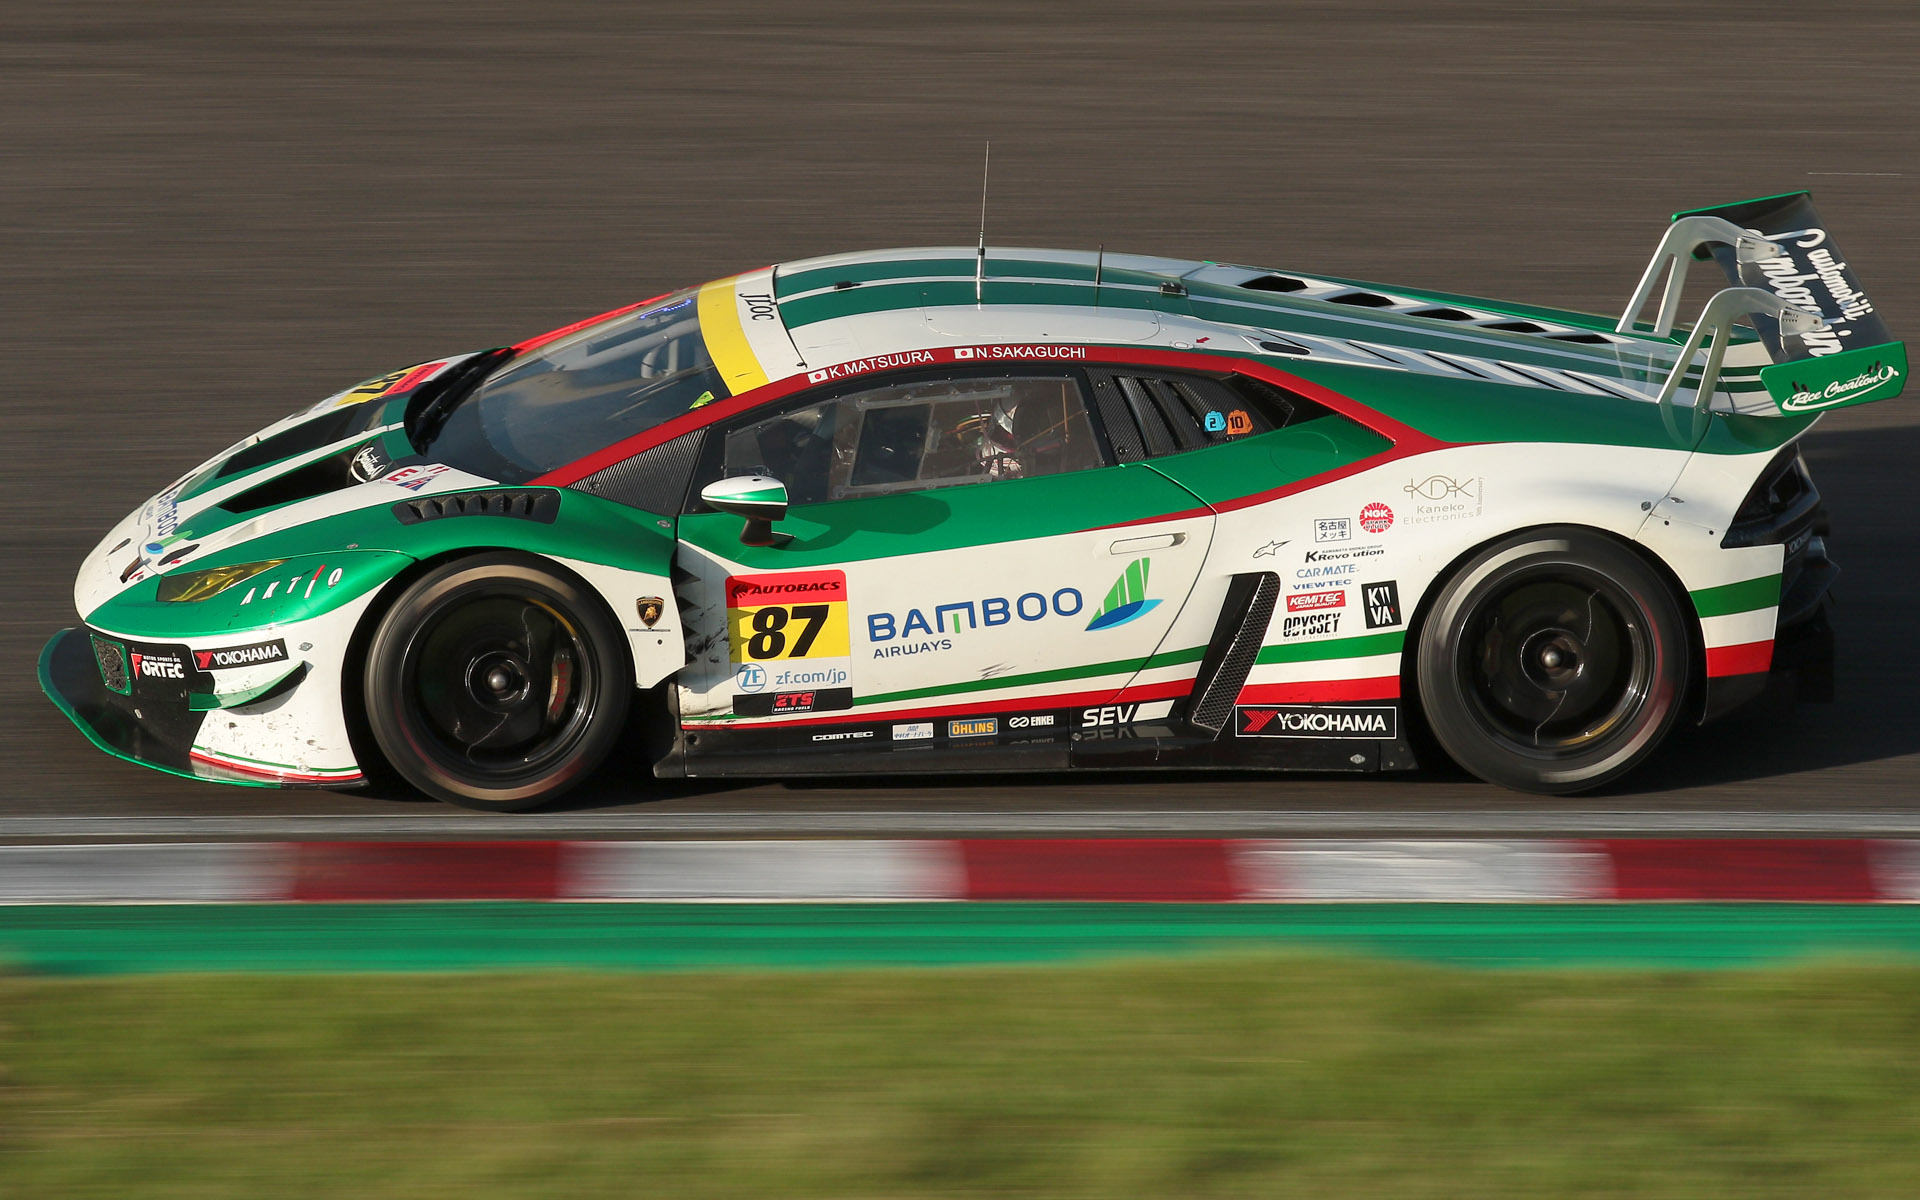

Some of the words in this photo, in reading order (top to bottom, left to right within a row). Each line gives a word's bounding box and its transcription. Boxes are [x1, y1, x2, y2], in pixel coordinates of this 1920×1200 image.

[738, 293, 777, 320] JLOC
[976, 346, 1086, 359] N.SAKAGUCHI
[828, 351, 934, 378] K.MATSUURA
[1792, 390, 1822, 406] Rice
[1824, 373, 1879, 398] Creation
[1209, 418, 1216, 429] 2
[1229, 416, 1245, 429] 10
[1364, 509, 1388, 518] NGK
[1416, 504, 1465, 514] Kaneko
[1319, 521, 1347, 530] 名古屋
[1403, 512, 1474, 525] Electronics
[1320, 530, 1347, 540] メッキ
[240, 564, 343, 606] AKTIO
[749, 581, 840, 595] AUTOBACS
[1292, 579, 1352, 590] VIEWTEC
[867, 587, 1083, 642] BAMBOO
[748, 604, 829, 660] 87
[1283, 612, 1341, 637] ODYSSEY
[212, 644, 282, 665] YOKOHAMA
[873, 639, 953, 659] AIRWAYS
[741, 669, 764, 687] ZF
[776, 668, 847, 684] zf.com/jp
[1031, 715, 1054, 726] ENKEI
[1082, 704, 1134, 728] SEV
[1277, 713, 1387, 731] YOKOHAMA
[952, 722, 994, 735] ÖHLINS
[812, 731, 874, 742] COMTEC
